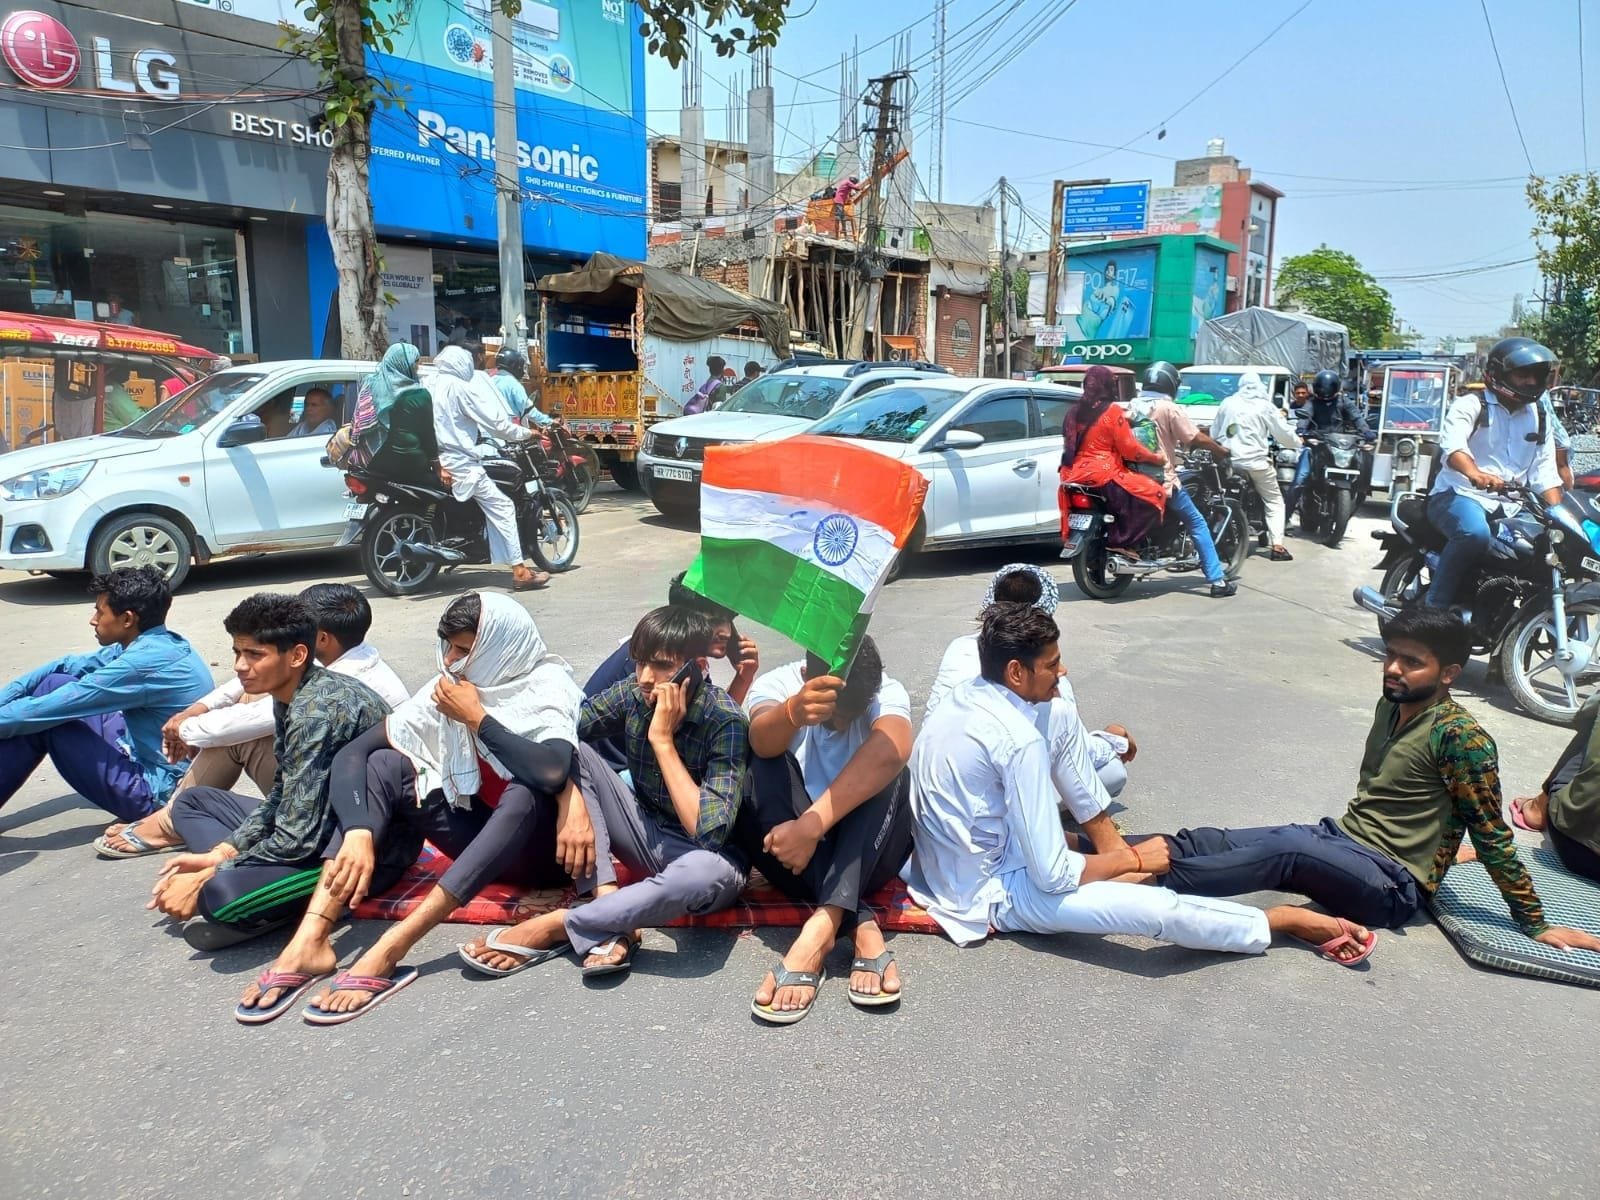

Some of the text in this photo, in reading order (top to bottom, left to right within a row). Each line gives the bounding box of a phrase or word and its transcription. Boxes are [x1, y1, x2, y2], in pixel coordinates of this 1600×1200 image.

[92, 36, 181, 100] LG
[523, 67, 548, 79] REMOVES
[231, 111, 334, 148] BEST SHO
[417, 109, 599, 182] Pansonic
[406, 152, 441, 167] PARTNER
[525, 176, 541, 186] SHRI
[541, 178, 565, 190] SHYAM
[565, 183, 605, 197] ELECTRONICS
[611, 192, 643, 204] FURNITURE
[391, 281, 420, 289] GLOBALLY
[395, 274, 415, 282] WORLD
[1116, 268, 1138, 287] F17
